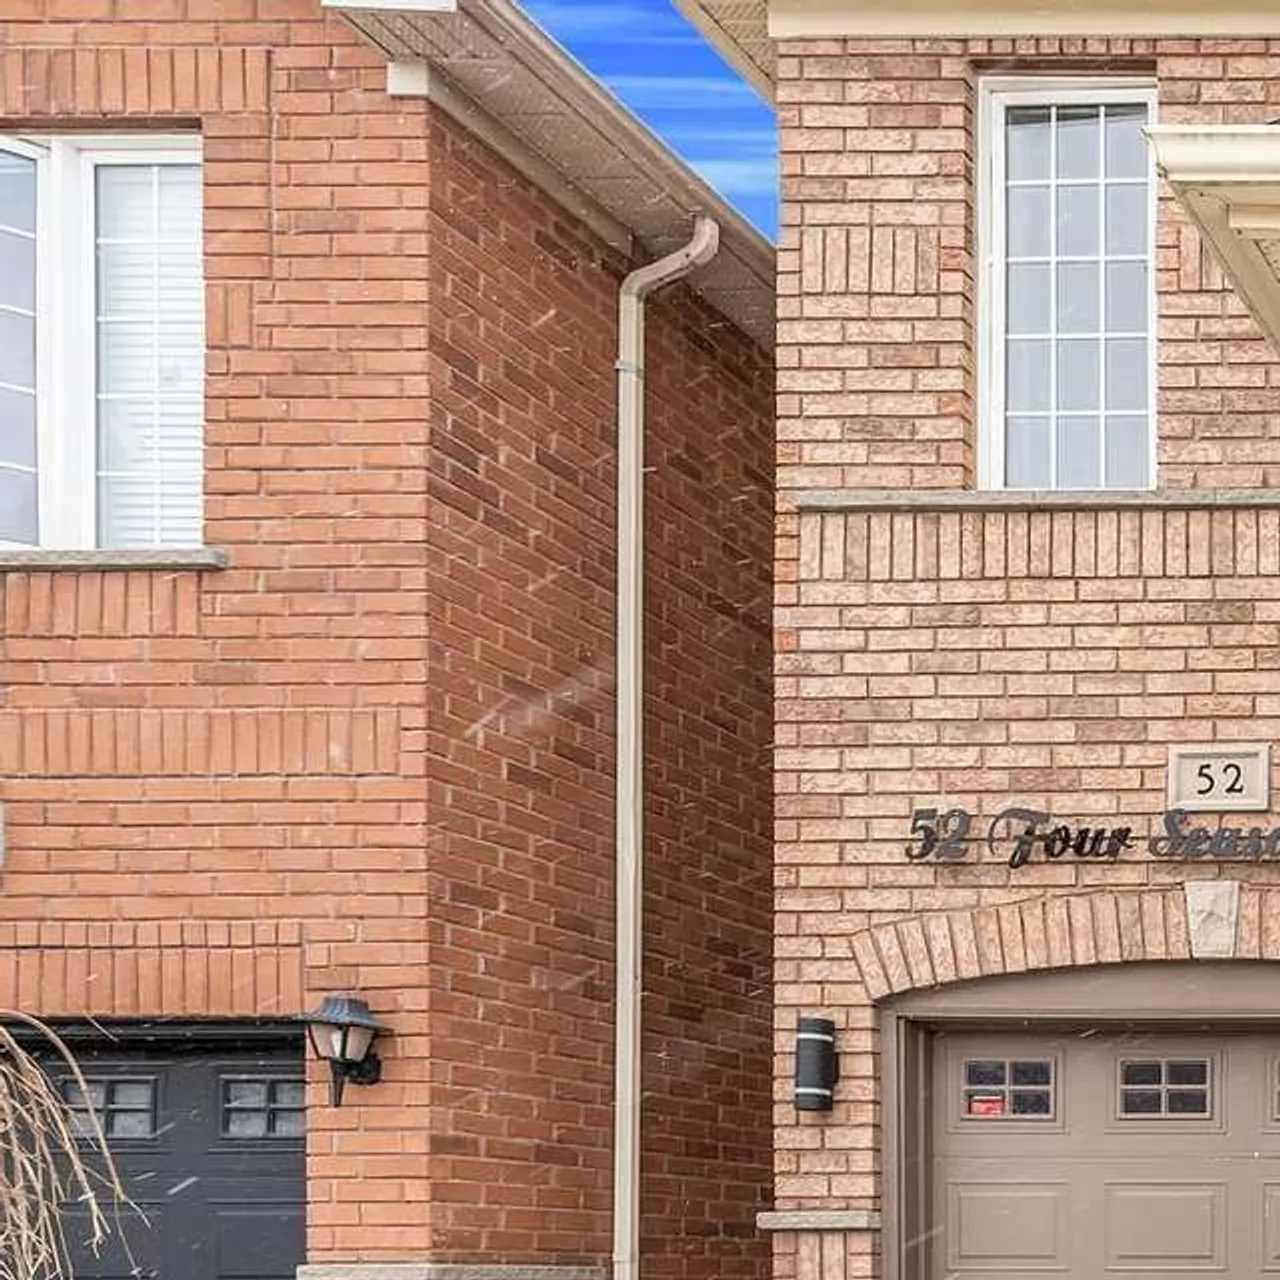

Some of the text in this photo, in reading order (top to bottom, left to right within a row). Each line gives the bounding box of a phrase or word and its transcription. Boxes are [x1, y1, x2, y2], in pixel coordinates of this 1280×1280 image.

[1196, 764, 1244, 795] 52
[904, 807, 971, 859] 52
[989, 807, 1134, 868] Four
